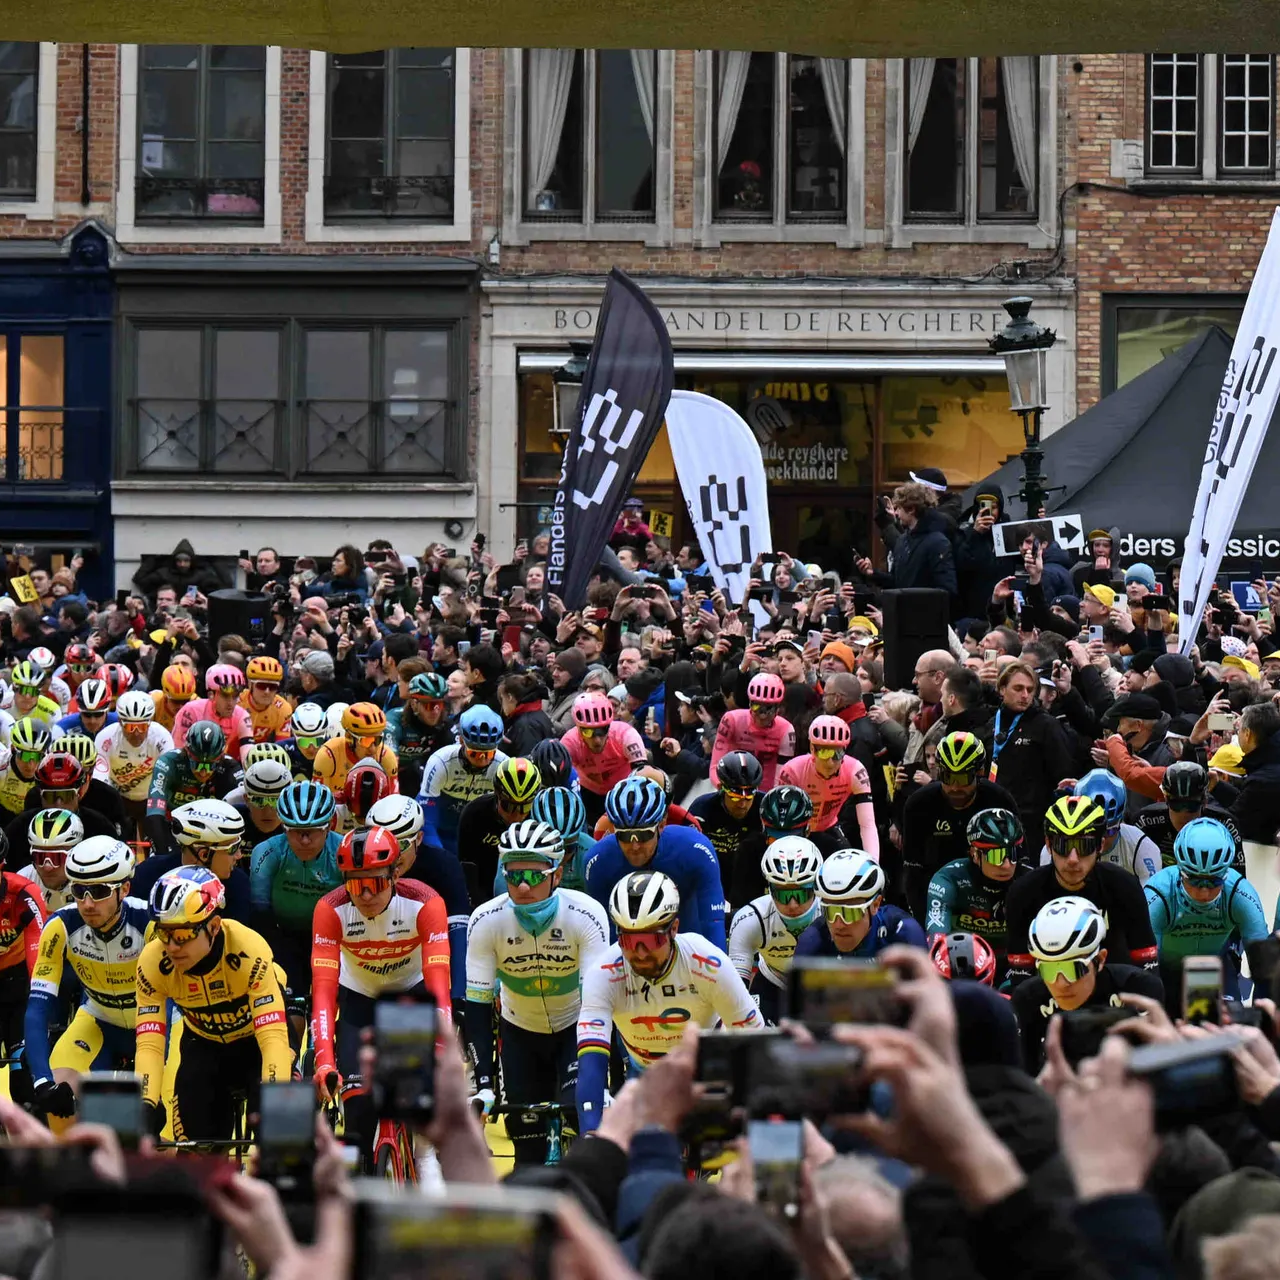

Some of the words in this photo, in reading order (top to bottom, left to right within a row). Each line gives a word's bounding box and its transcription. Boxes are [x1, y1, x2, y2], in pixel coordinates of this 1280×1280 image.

[554, 310, 769, 332] BOANDEL
[784, 312, 821, 332] DE
[788, 442, 848, 464] reyghere
[766, 461, 838, 480] oekhandel
[548, 491, 566, 586] Flanders
[77, 949, 105, 962] baloise
[502, 953, 576, 964] ASTANA
[106, 976, 137, 985] Fland
[255, 1014, 280, 1026] HEMA
[319, 1008, 329, 1040] TREK
